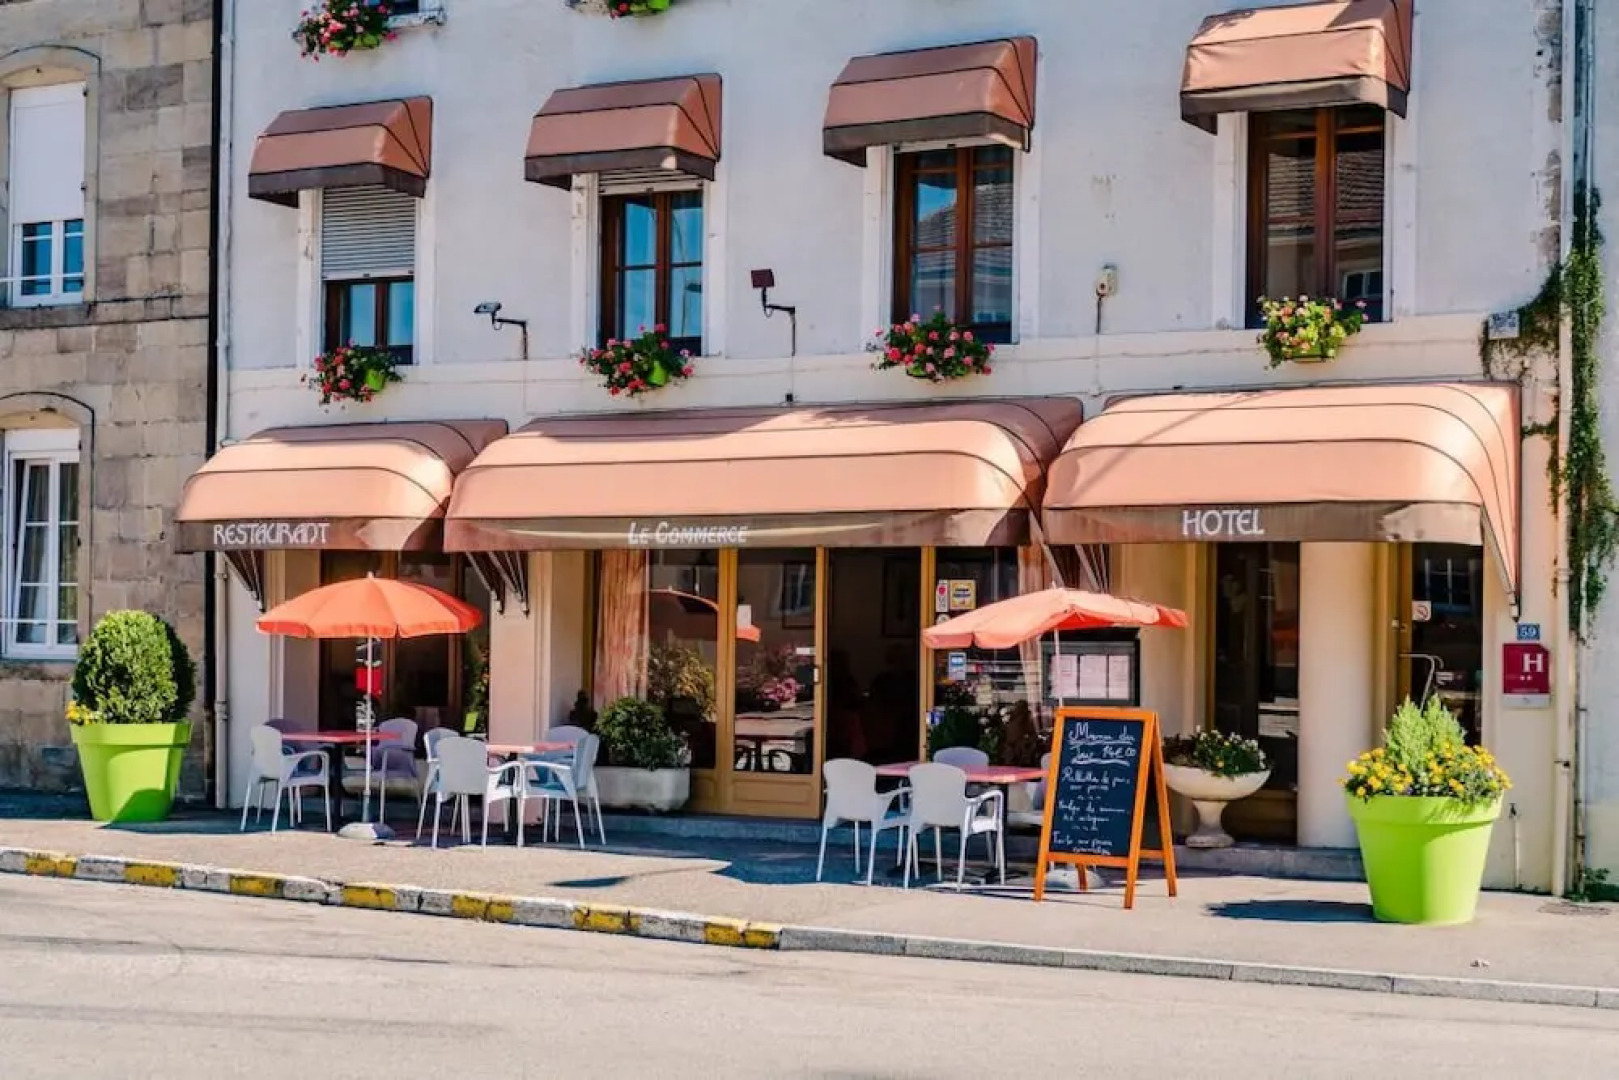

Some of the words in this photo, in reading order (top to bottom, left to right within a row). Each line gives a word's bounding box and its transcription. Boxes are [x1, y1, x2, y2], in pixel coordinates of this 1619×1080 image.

[213, 522, 331, 545] RESTAURANT
[655, 521, 748, 545] COMMERCE
[1182, 508, 1265, 536] HOTEL
[1520, 626, 1537, 637] 59
[1523, 653, 1544, 673] H
